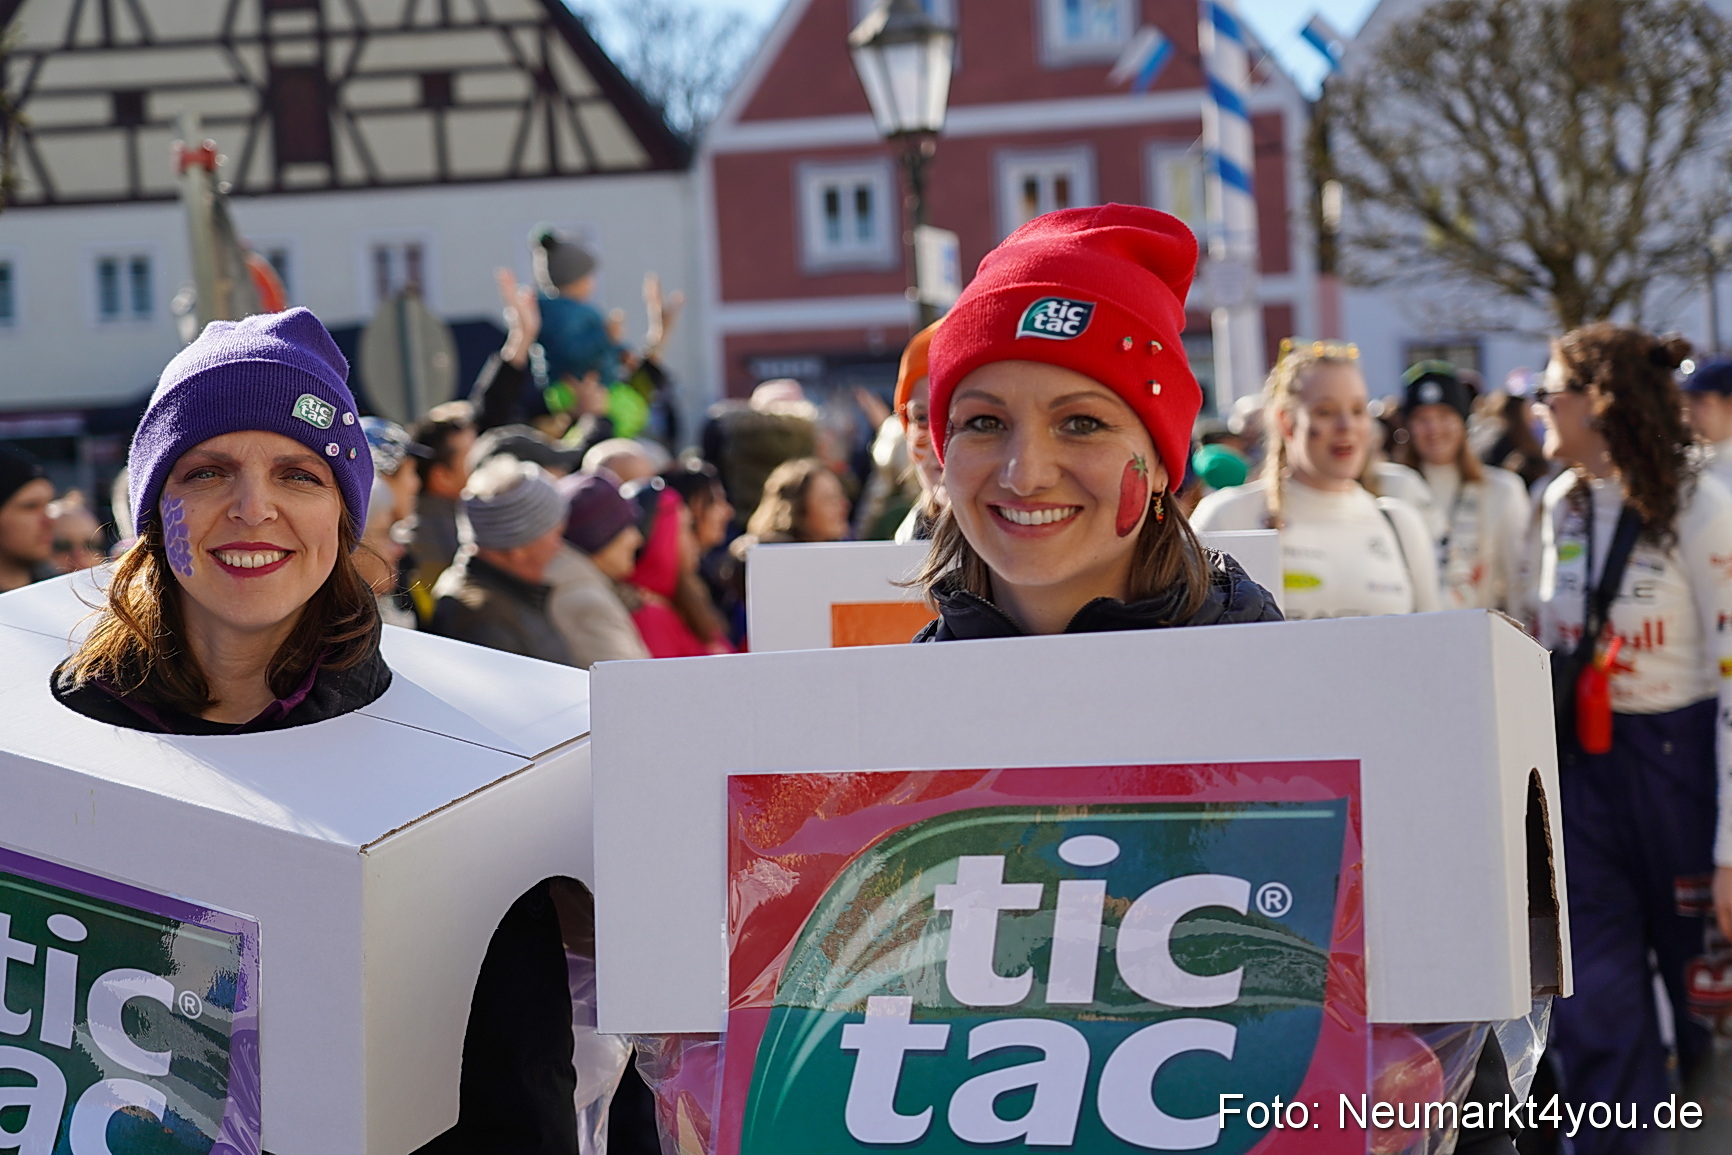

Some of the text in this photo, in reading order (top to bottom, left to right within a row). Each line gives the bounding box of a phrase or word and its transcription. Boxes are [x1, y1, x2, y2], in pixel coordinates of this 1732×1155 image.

[1047, 301, 1085, 321] tic
[1034, 312, 1080, 335] tac
[301, 404, 327, 427] tac
[308, 398, 330, 418] tic
[840, 995, 1238, 1151] tac
[0, 1045, 167, 1155] ac
